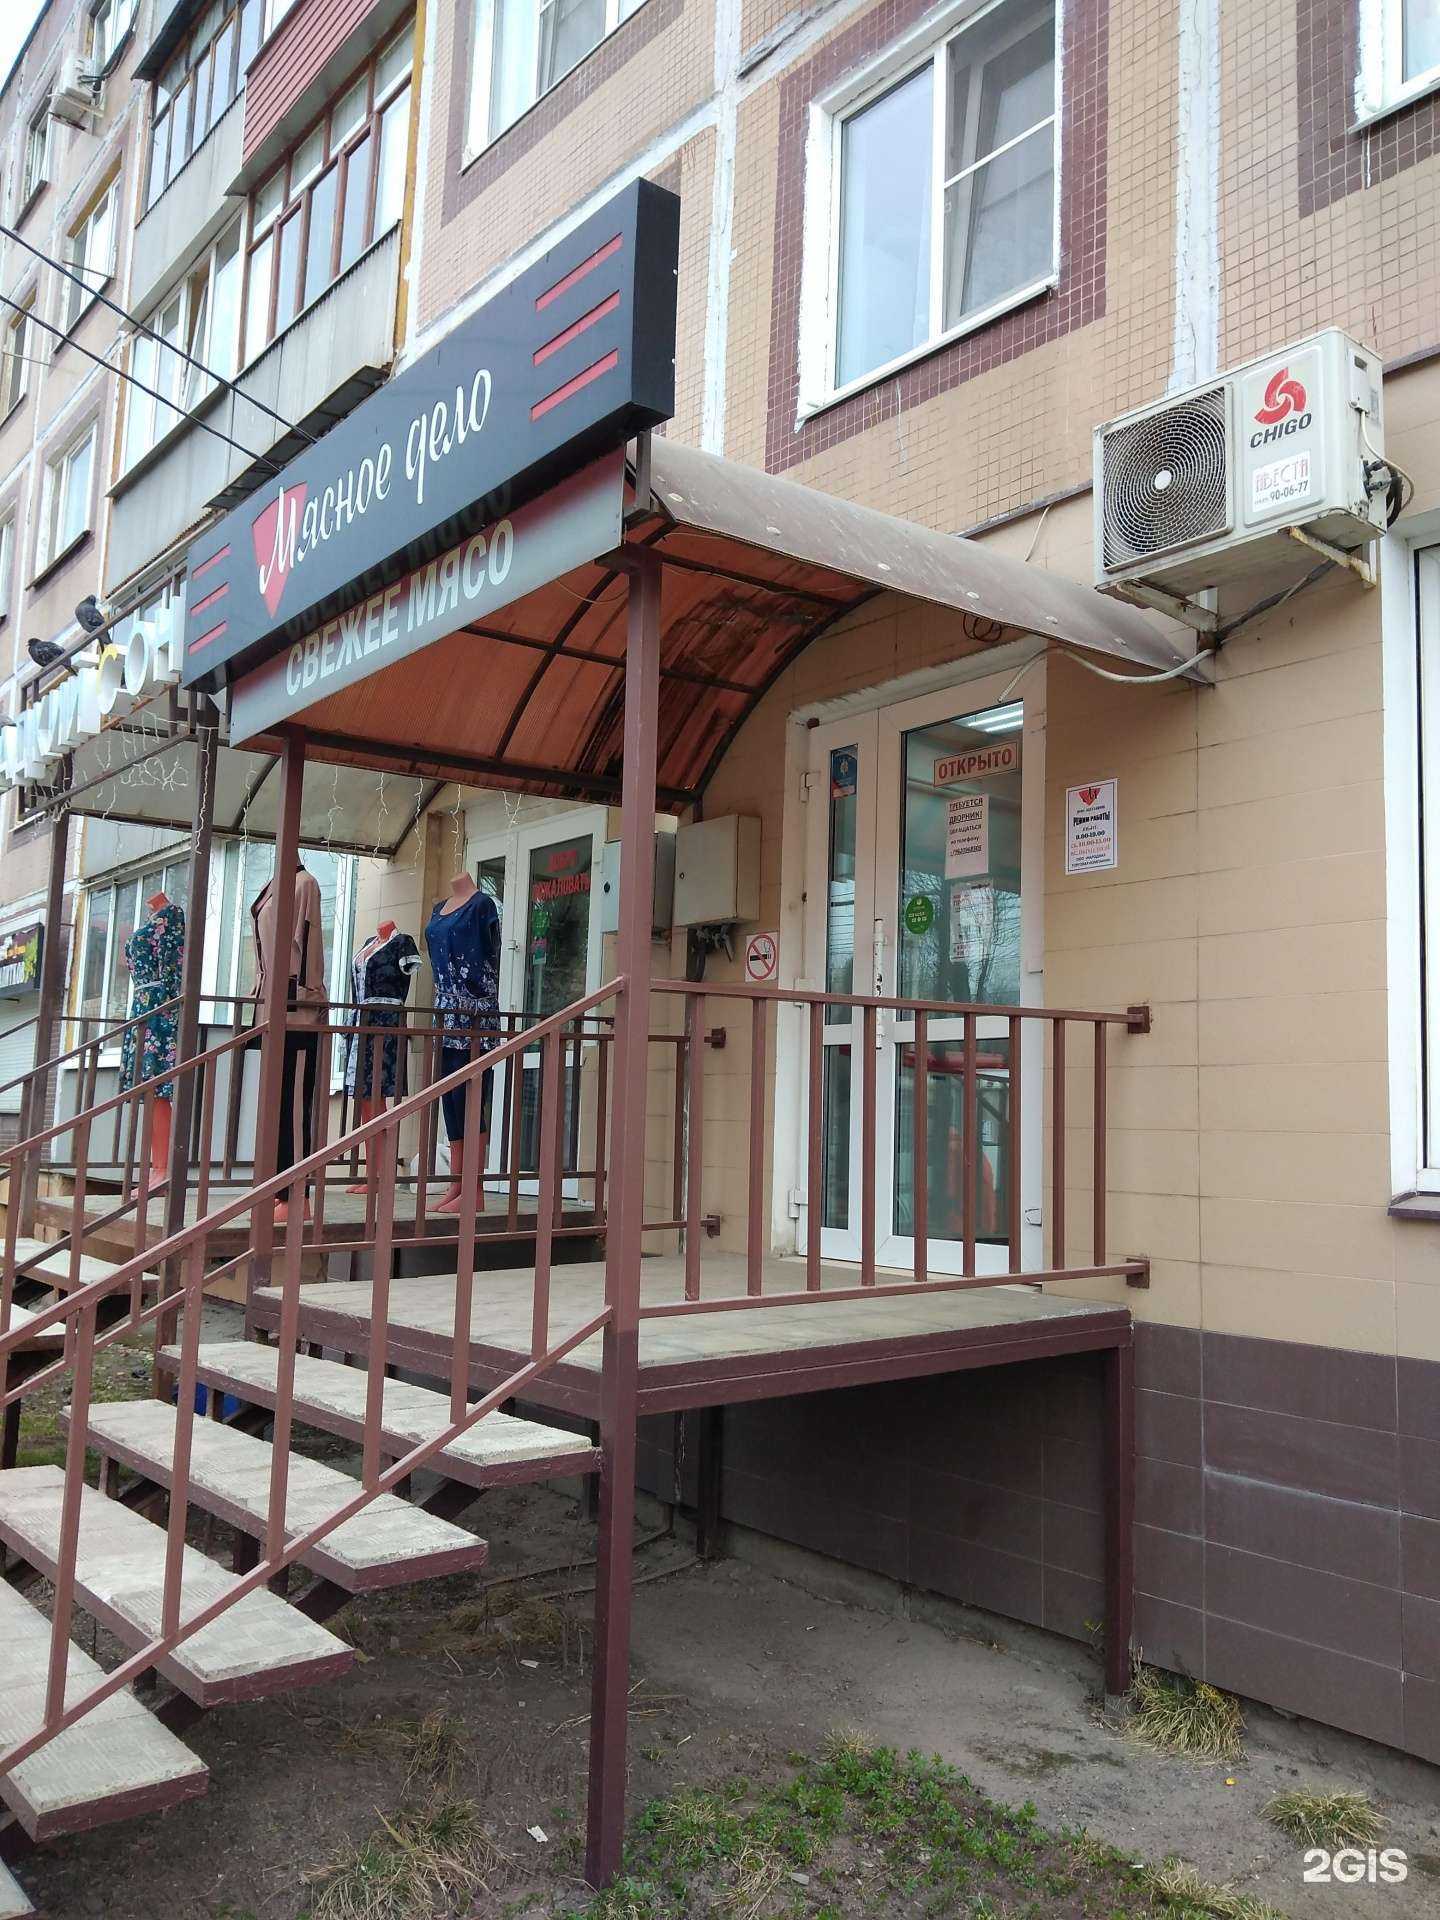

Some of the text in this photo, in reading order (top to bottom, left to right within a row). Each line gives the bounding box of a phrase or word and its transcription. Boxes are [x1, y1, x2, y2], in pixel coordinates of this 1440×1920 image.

[259, 368, 492, 595] Мясное дело
[1250, 413, 1312, 448] CHIGO
[286, 519, 514, 696] СВЕЖЕЕ МЯСО
[938, 748, 1012, 779] ОТКРЫТО
